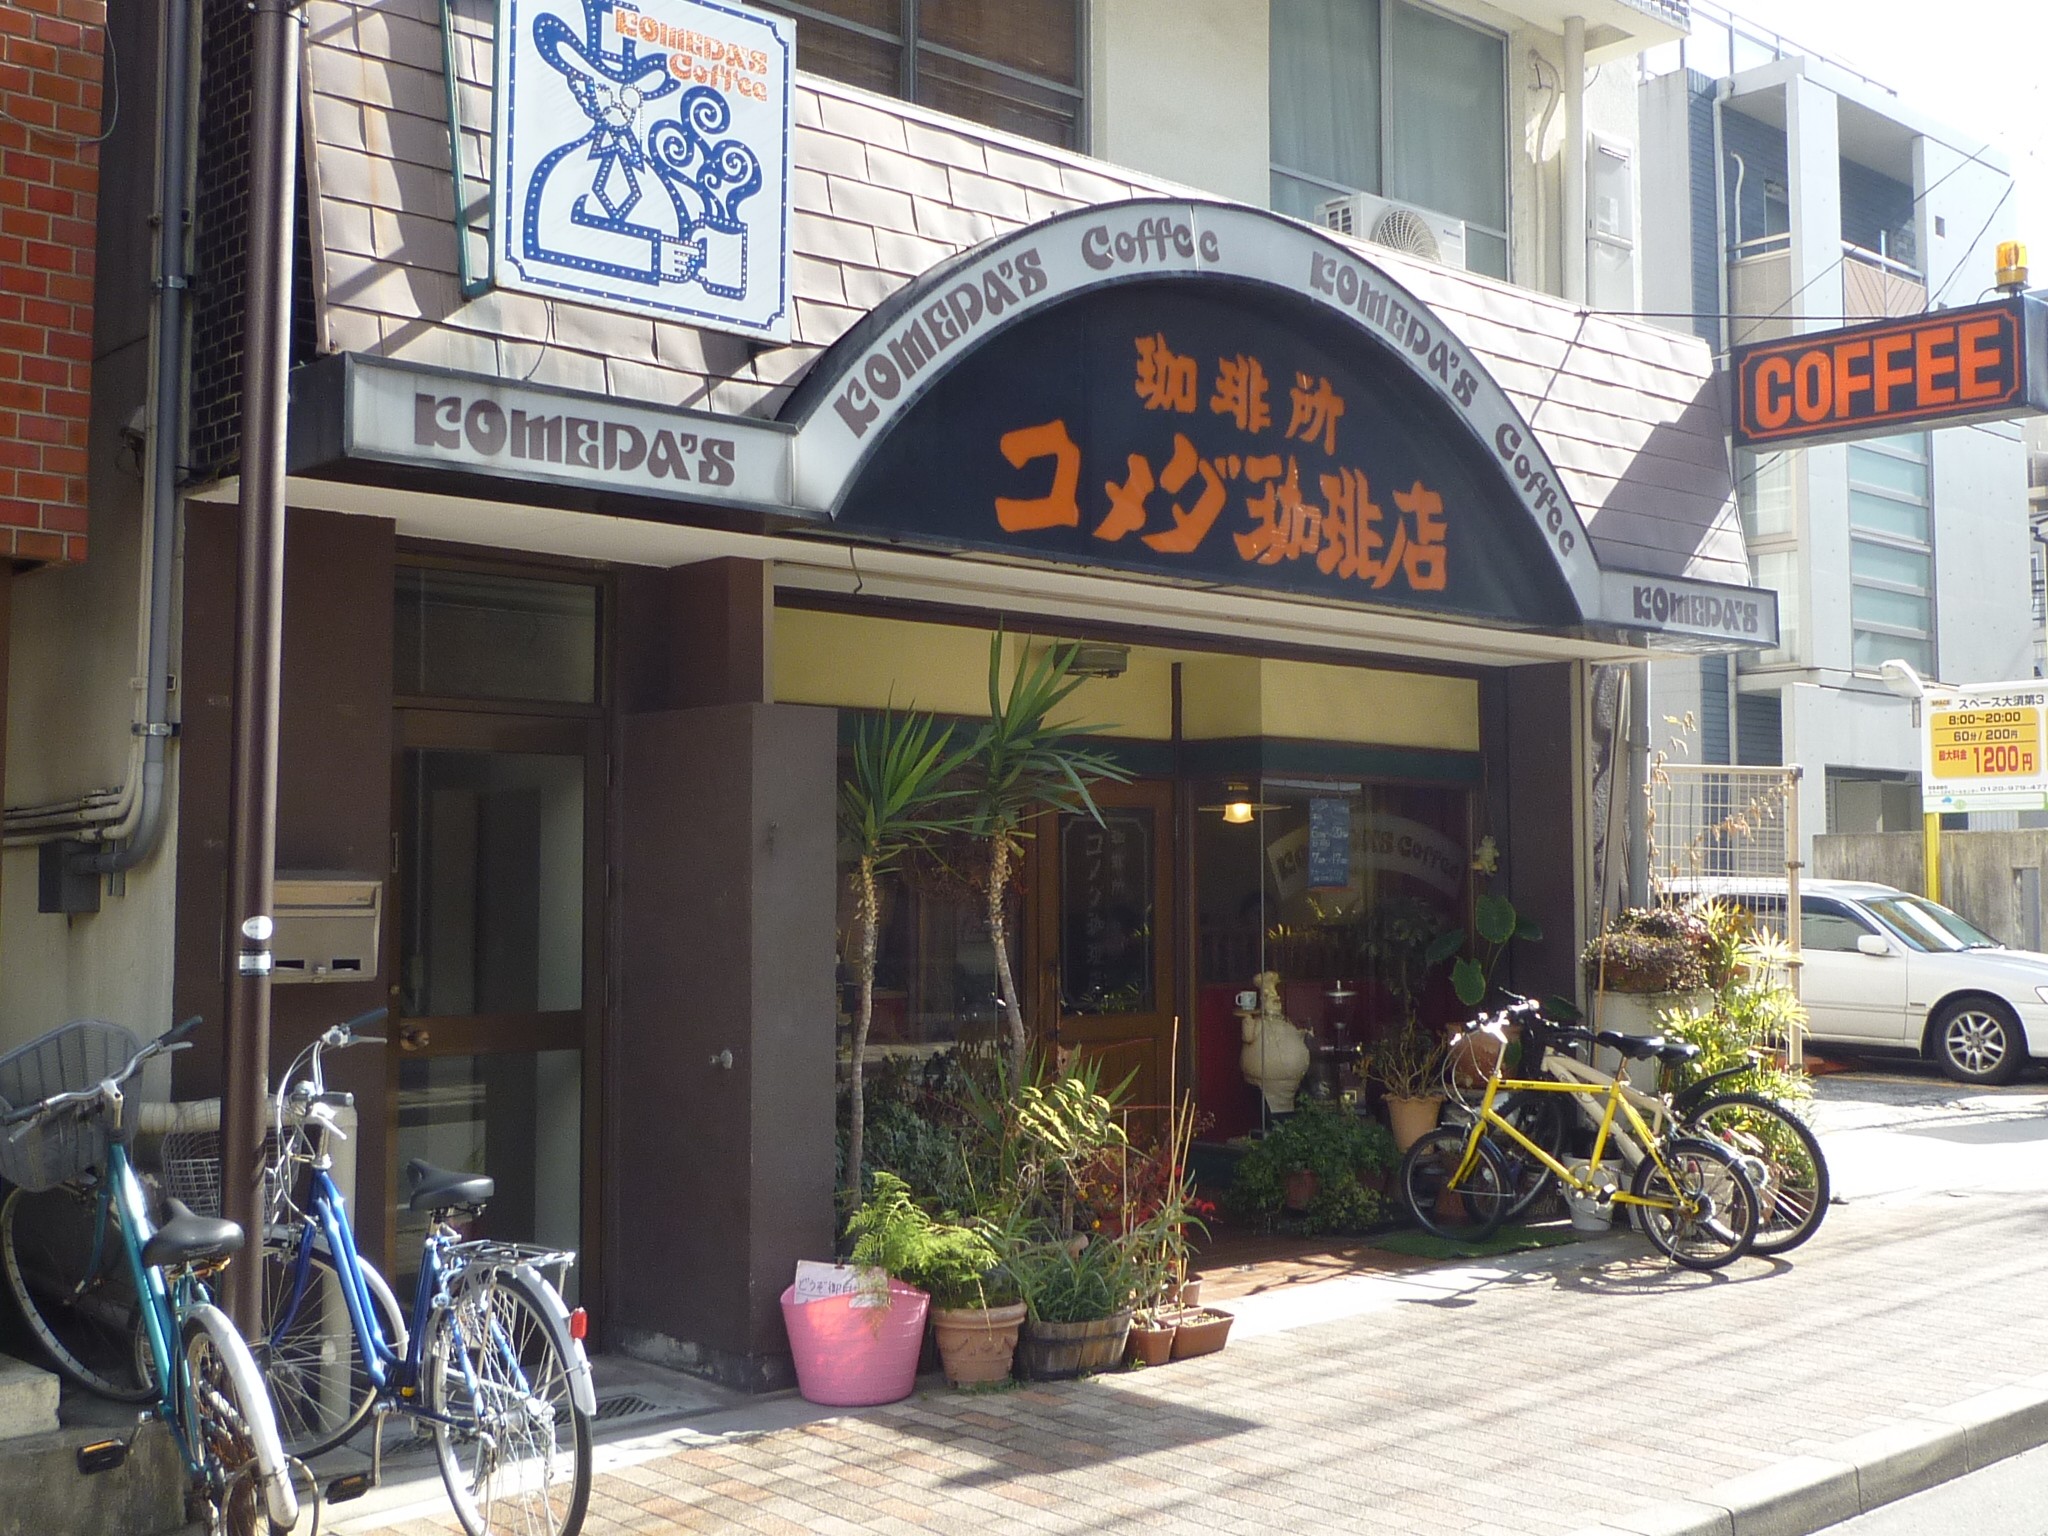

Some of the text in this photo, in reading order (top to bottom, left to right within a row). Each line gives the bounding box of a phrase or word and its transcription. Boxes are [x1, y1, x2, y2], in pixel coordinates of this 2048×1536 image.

[615, 9, 768, 75] KOMEDA'S
[669, 53, 768, 101] Coffee
[833, 216, 1221, 439] KOMEDA'S Coffee
[1753, 318, 2001, 431] COFFEE
[414, 393, 736, 488] KOMEDA'S
[1134, 331, 1345, 456] 珈琲所
[1310, 251, 1575, 557] KOMEDA'S Coffee
[994, 418, 1448, 590] コメダ珈琲店
[1633, 586, 1758, 634] KOMEDA'S
